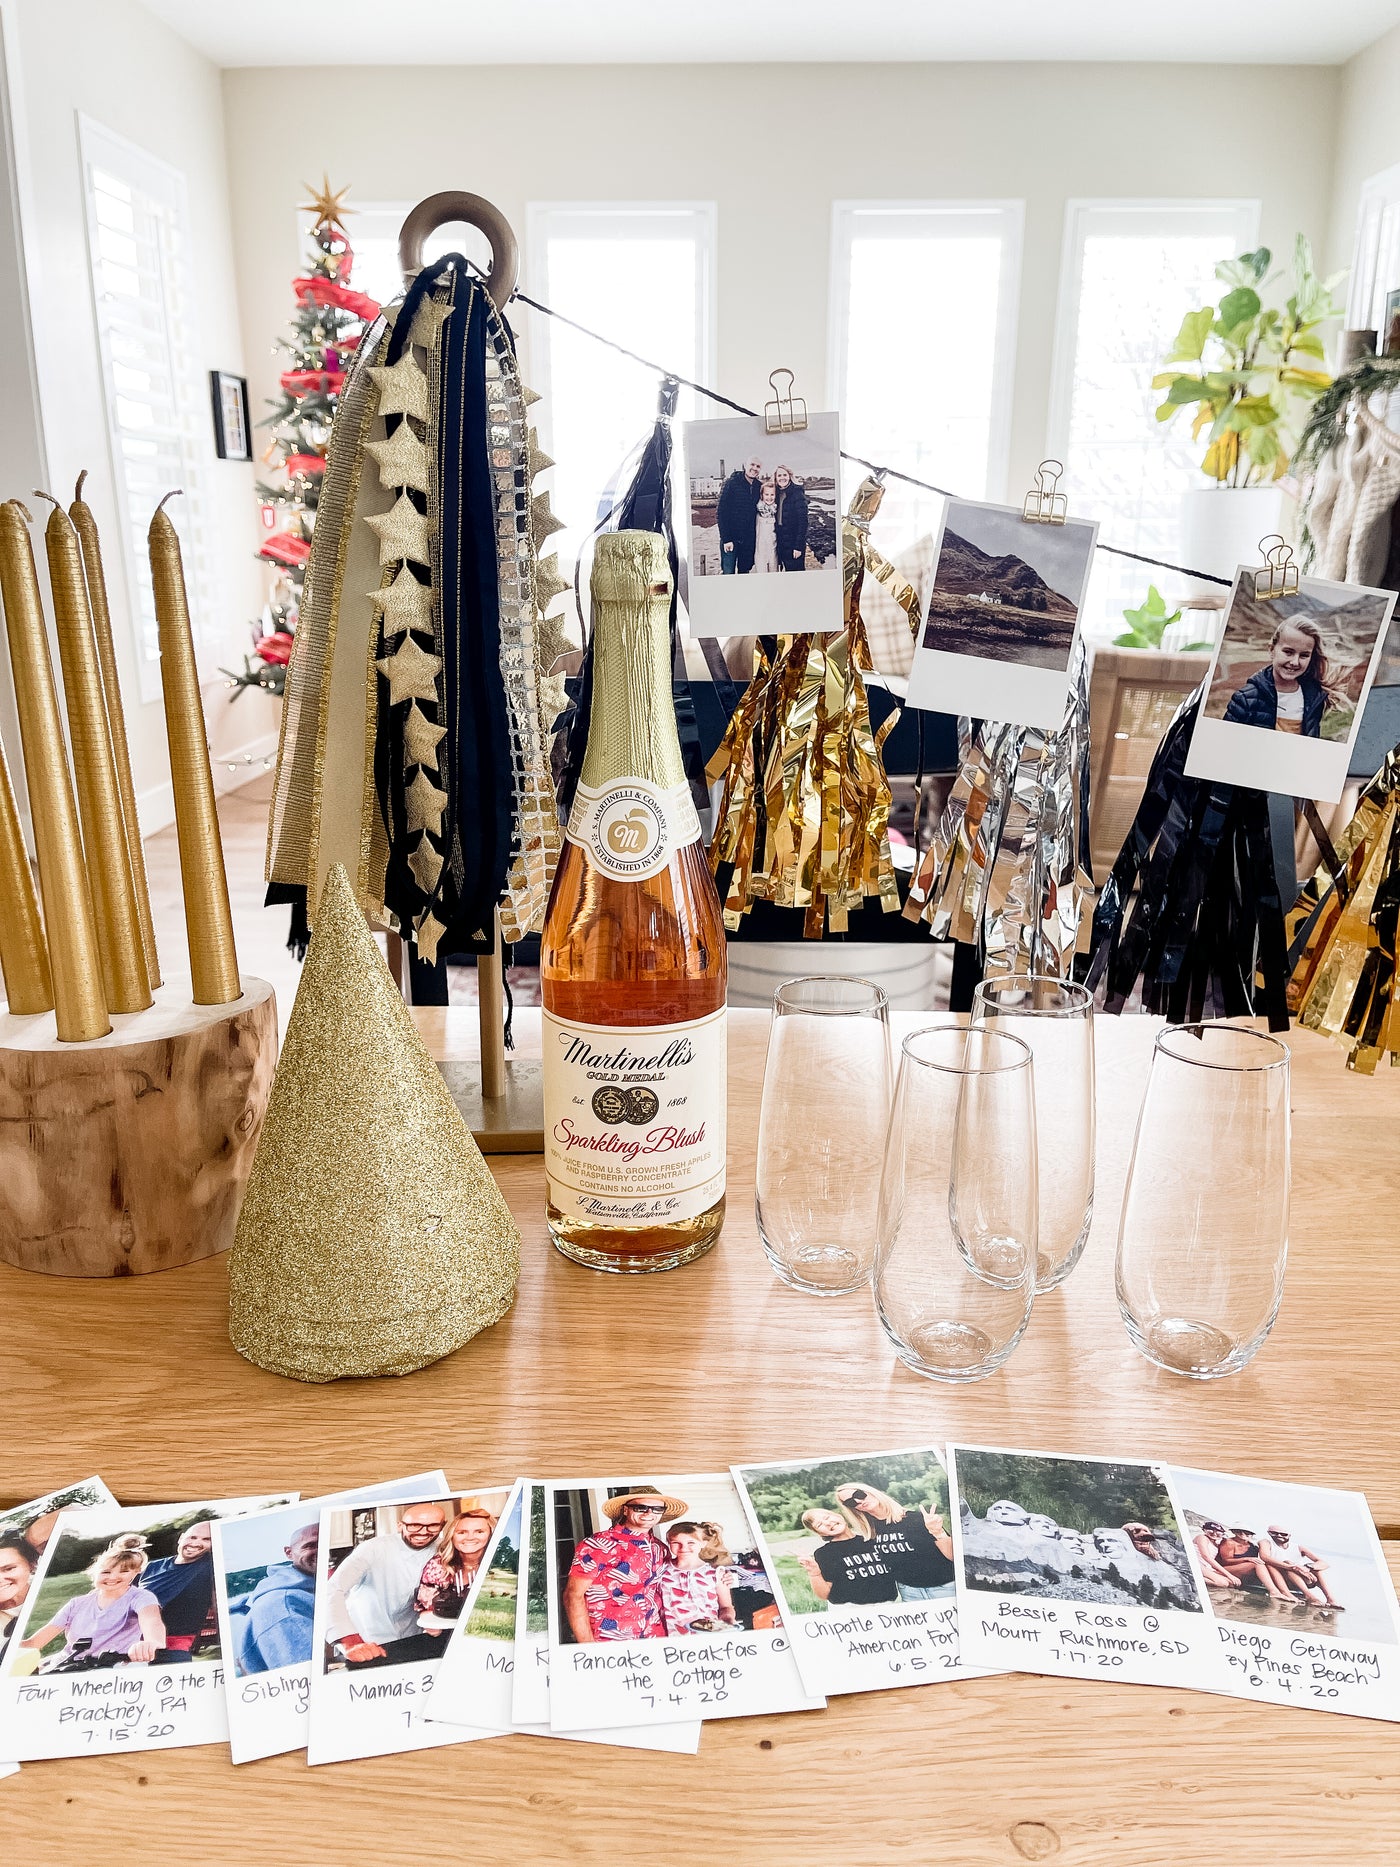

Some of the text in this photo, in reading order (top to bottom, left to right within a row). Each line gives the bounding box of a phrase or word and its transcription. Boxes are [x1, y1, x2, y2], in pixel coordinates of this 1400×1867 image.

[594, 790, 632, 821] MARTINELLI
[642, 795, 667, 830] COMPANY
[594, 844, 664, 872] ESTABLISHED IN 1868
[558, 1032, 697, 1070] Martinelli's
[586, 1071, 666, 1082] GOLD MEDAL
[666, 1096, 688, 1108] 1868
[553, 1118, 706, 1162] Sparkling Blush
[562, 1157, 582, 1168] JUICE
[582, 1162, 606, 1172] FROM
[626, 1164, 658, 1174] GROWN
[660, 1160, 686, 1172] FRESH
[687, 1152, 712, 1166] APPLES
[566, 1165, 692, 1182] AND RASPBERRY CONCENTRATE
[580, 1180, 619, 1192] CONTAINS
[636, 1182, 676, 1192] ALCOHOL
[589, 1198, 646, 1212] Martinelli
[650, 1200, 662, 1210] &
[876, 1532, 904, 1543] HOME
[842, 1552, 882, 1566] HOME
[846, 1564, 891, 1580] S'COOL
[804, 1616, 874, 1642] Chipotle
[878, 1611, 928, 1628] Dinner
[998, 1602, 1160, 1632] Bessie Ross @
[848, 1636, 922, 1658] American
[982, 1620, 1041, 1642] Mount
[1160, 1640, 1190, 1654] SD
[573, 1650, 654, 1672] Pancake
[771, 1638, 790, 1652] @
[1218, 1626, 1381, 1678] Diego Getaway
[622, 1665, 742, 1690] the Cottage
[1254, 1656, 1302, 1675] Pines
[1312, 1663, 1369, 1685] Beach
[17, 1683, 60, 1704] Four
[72, 1676, 144, 1704] Wheeling
[156, 1676, 173, 1693] @
[179, 1674, 206, 1690] the
[160, 1696, 187, 1713] PA
